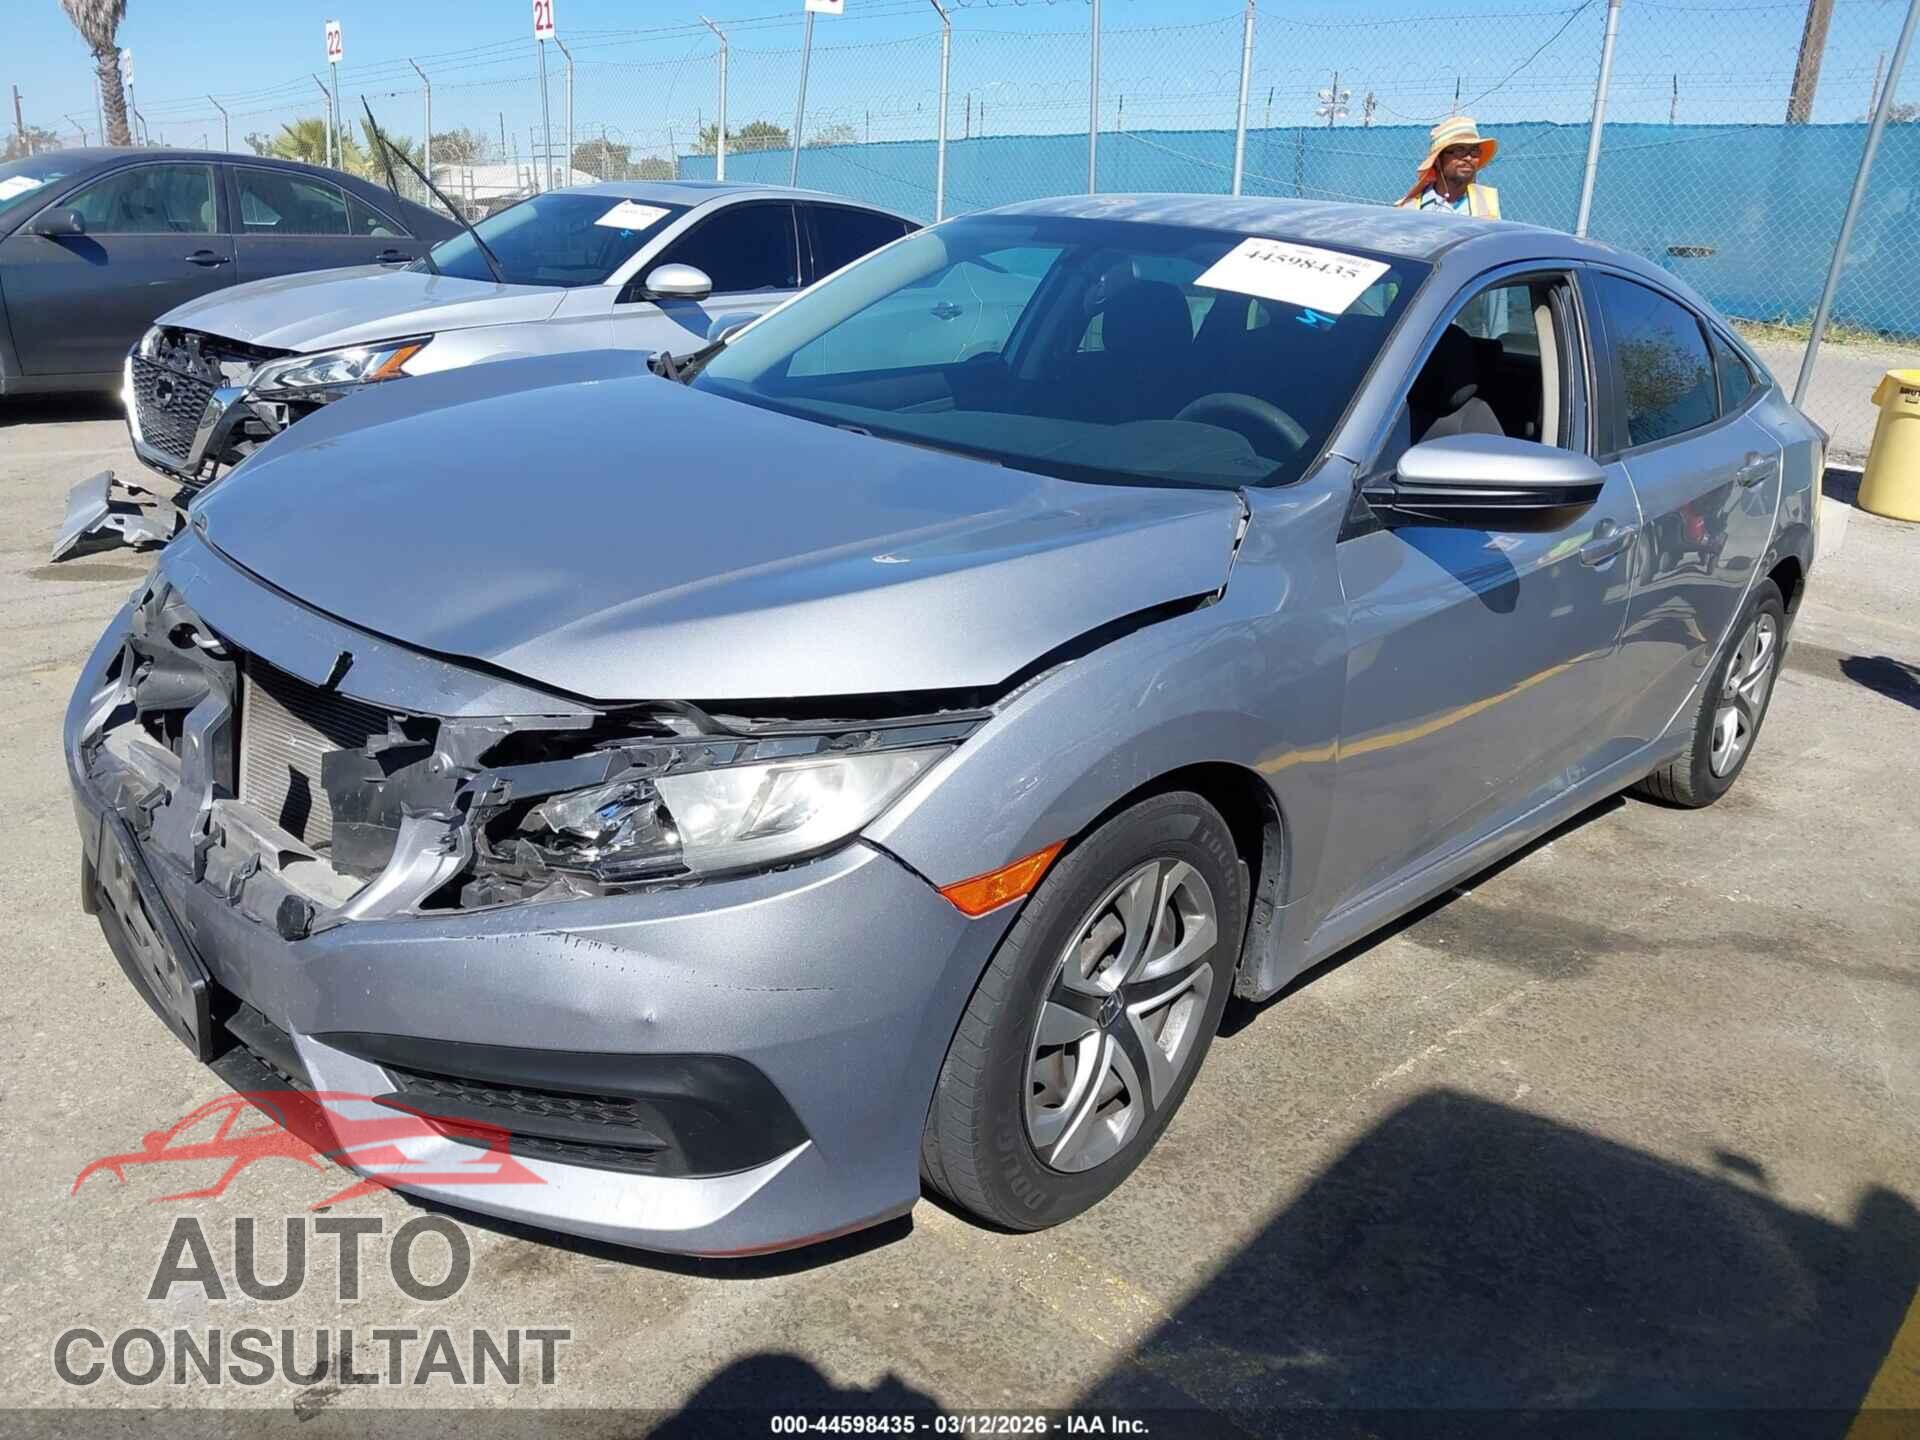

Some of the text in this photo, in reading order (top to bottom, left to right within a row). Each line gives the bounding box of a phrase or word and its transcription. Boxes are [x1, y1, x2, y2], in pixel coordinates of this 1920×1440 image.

[534, 1, 553, 31] 21
[327, 30, 342, 55] 22
[1244, 249, 1361, 278] 44598435
